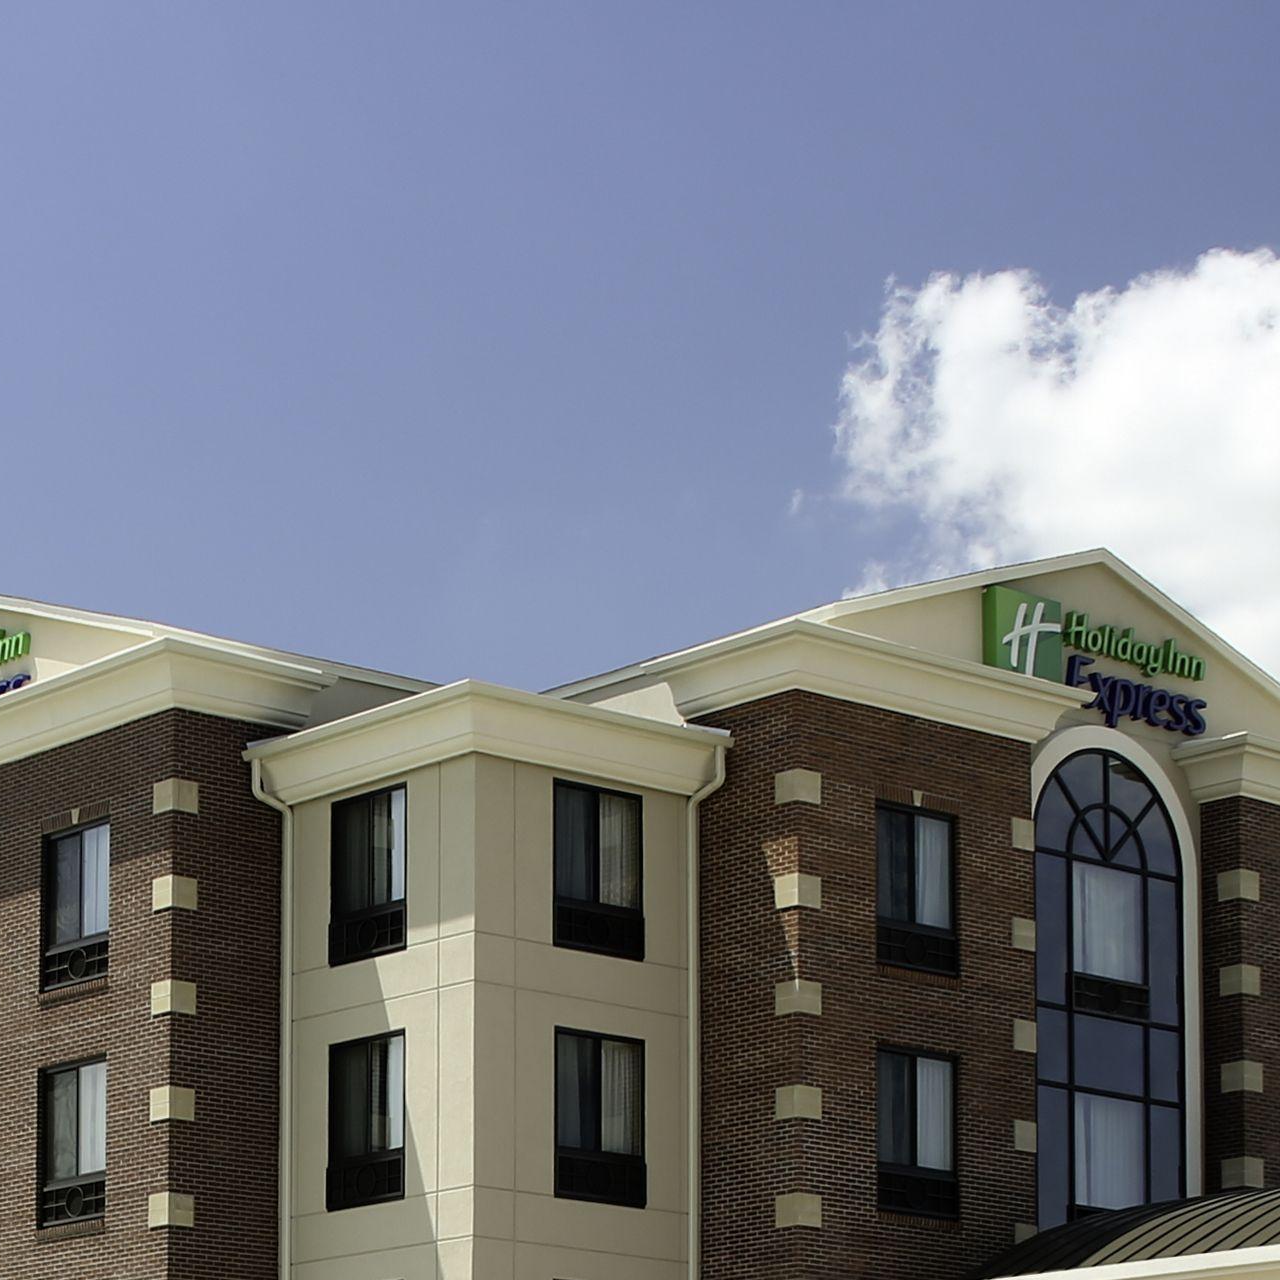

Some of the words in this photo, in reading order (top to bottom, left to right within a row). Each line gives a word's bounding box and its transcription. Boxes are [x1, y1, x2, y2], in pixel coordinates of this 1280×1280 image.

[1063, 610, 1164, 677] Holiday
[1163, 638, 1207, 682] Inn
[1065, 654, 1208, 736] Express
